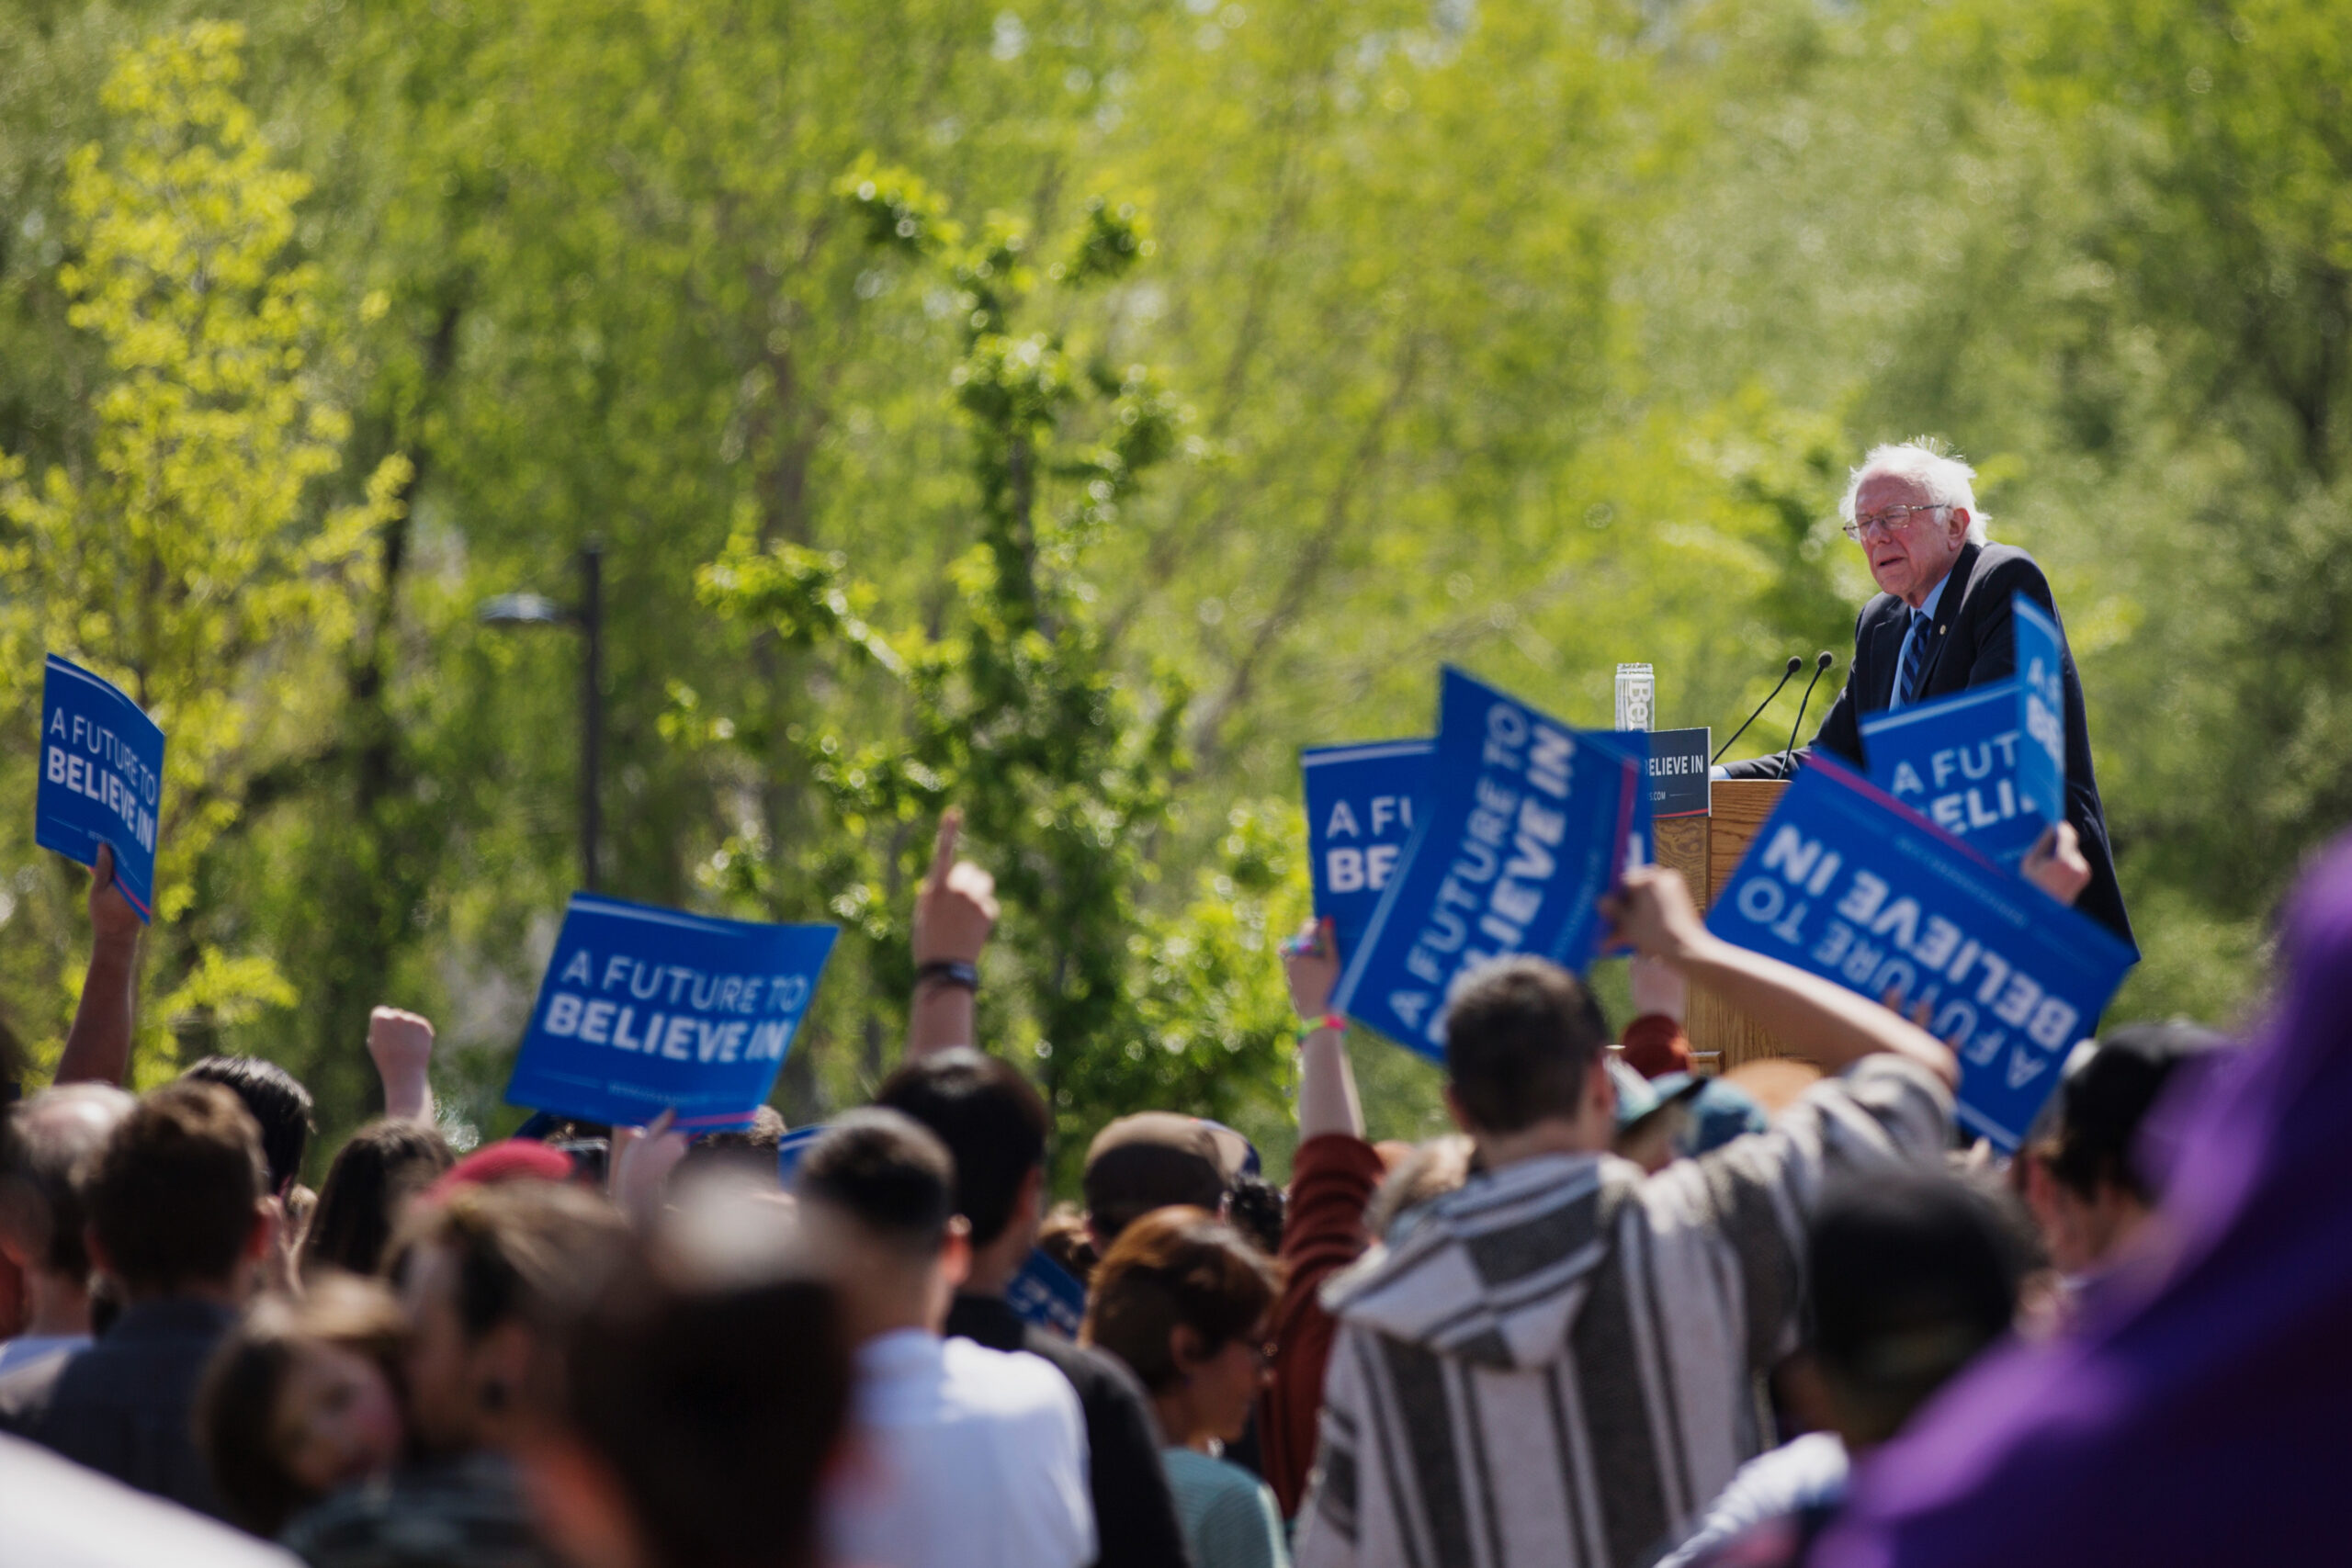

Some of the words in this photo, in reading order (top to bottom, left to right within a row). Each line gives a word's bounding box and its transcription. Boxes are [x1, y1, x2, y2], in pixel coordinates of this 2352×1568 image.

[49, 706, 67, 739] A
[73, 714, 139, 787] FUTURE
[140, 763, 156, 807] TO
[1484, 703, 1528, 770] TO
[1691, 755, 1703, 773] IN
[47, 745, 136, 833] BELIEVE
[136, 806, 155, 854] IN
[1892, 761, 1925, 797] A
[1914, 778, 2036, 836] ELI
[1326, 799, 1360, 839] A
[1406, 775, 1520, 986] FUTURE
[1425, 795, 1568, 1046] LIEVE
[1525, 723, 1577, 800] IN
[1761, 823, 1842, 897] IN
[1736, 875, 1808, 946] TO
[560, 949, 592, 987] A
[602, 954, 763, 1013] FUTURE
[765, 974, 809, 1013] TO
[1811, 919, 2007, 1067] FUTURE
[1835, 869, 2080, 1053] BELIEVE
[543, 991, 748, 1064] BELIEVE
[744, 1019, 794, 1062] IN
[1389, 989, 1430, 1031] A
[2006, 1043, 2048, 1089] A
